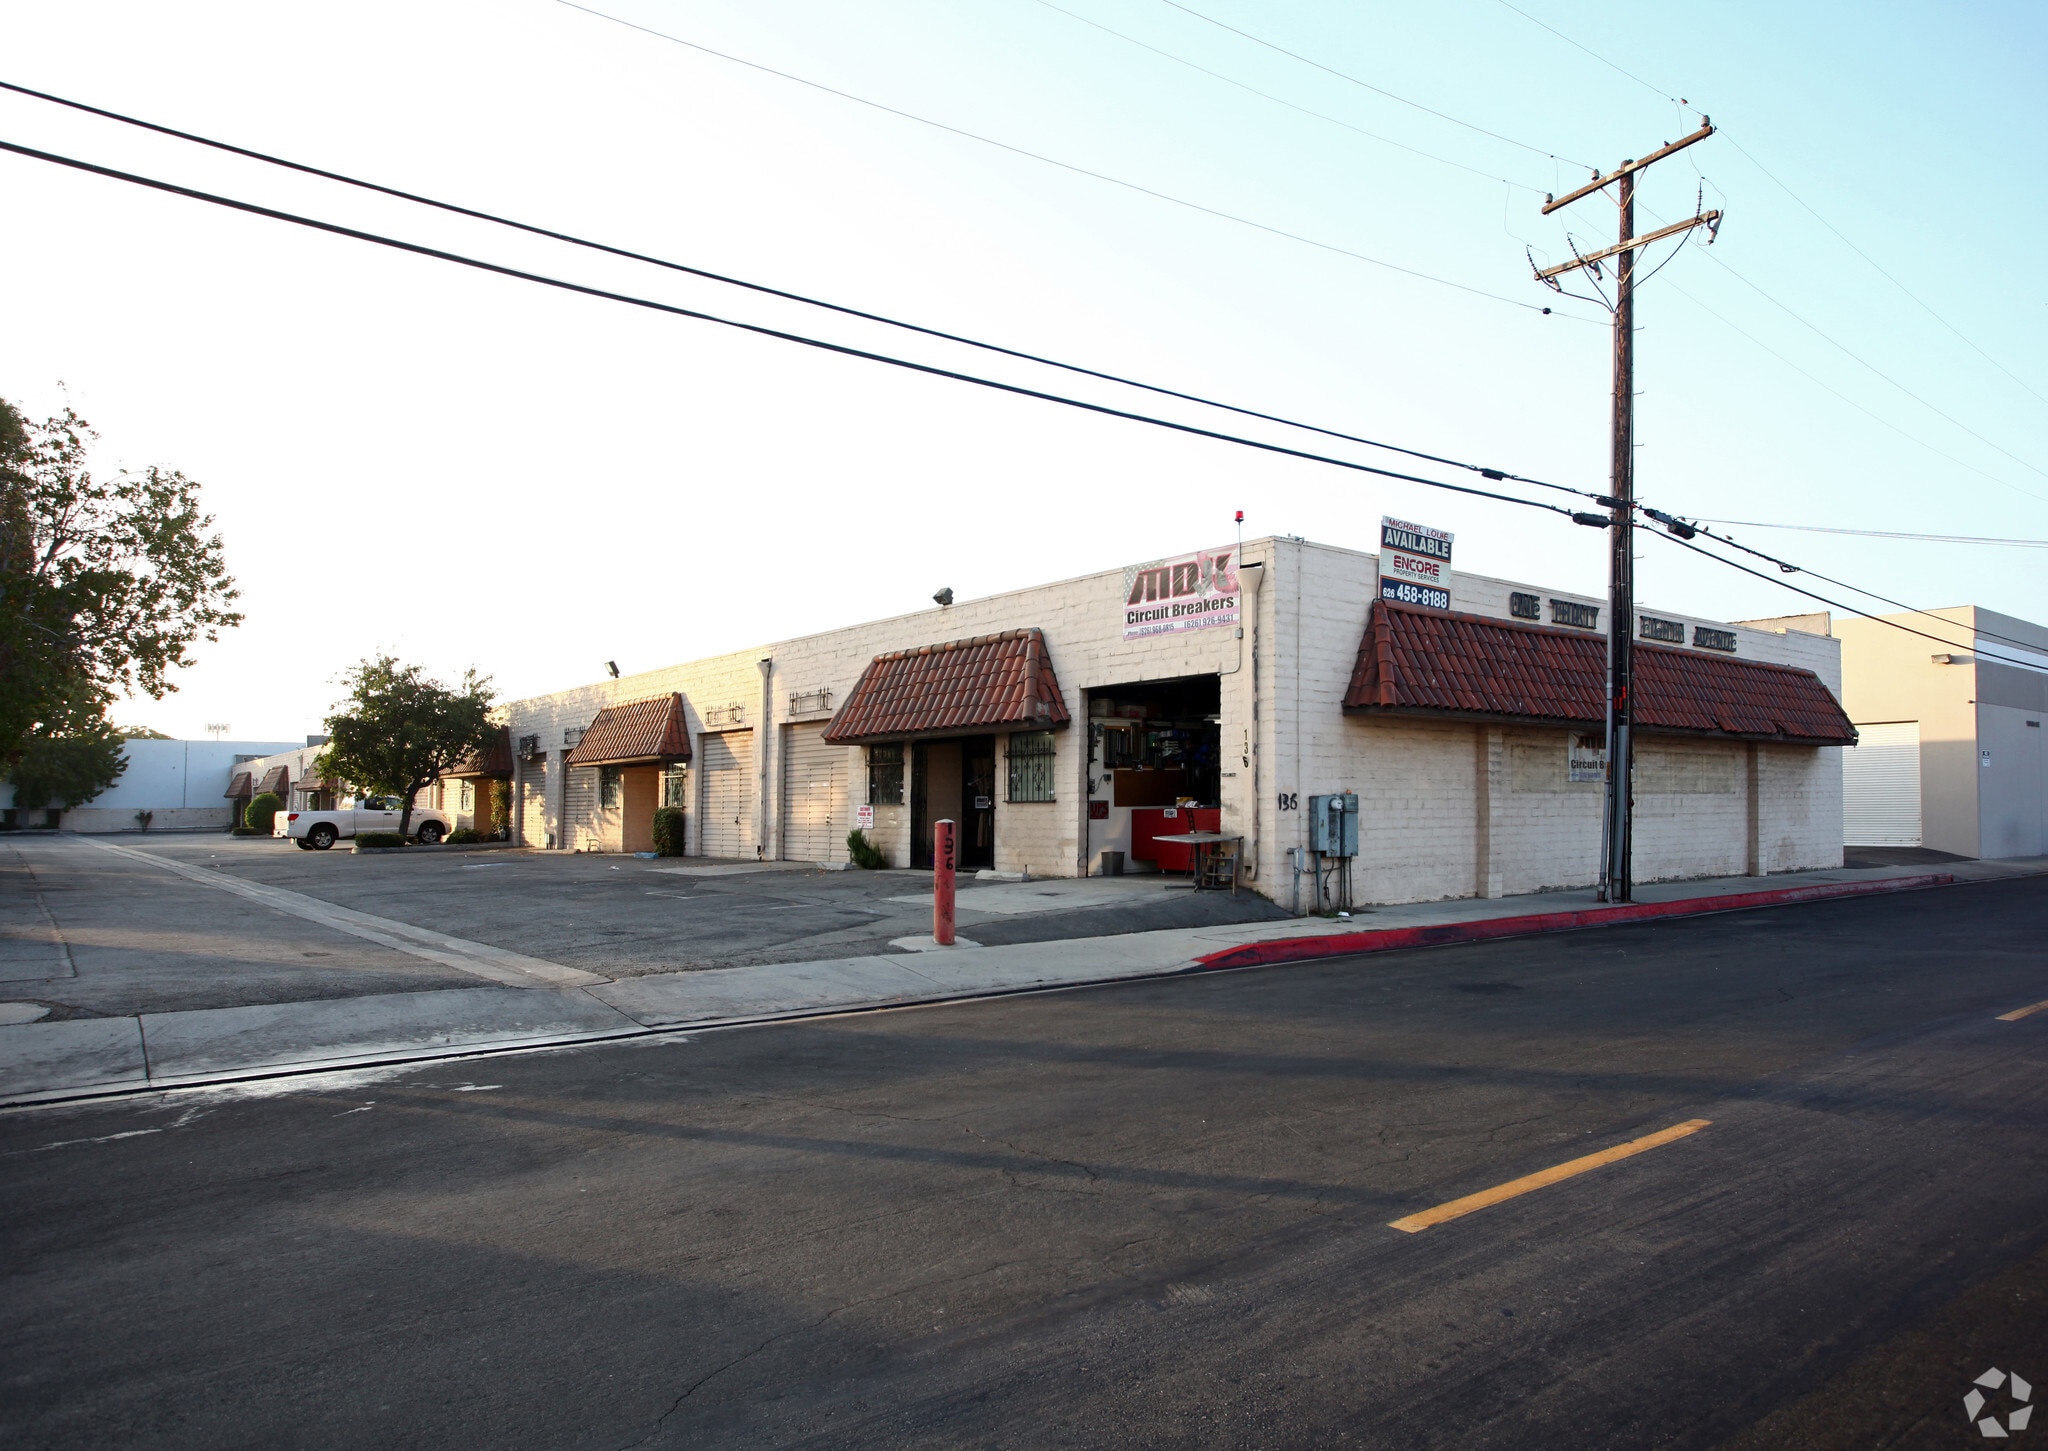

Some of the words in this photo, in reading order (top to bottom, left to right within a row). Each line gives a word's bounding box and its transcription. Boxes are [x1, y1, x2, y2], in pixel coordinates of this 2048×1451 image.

[1389, 519, 1422, 534] MICHAEL
[1426, 529, 1449, 540] LOUIE
[1385, 528, 1449, 557] AVAILABLE
[1393, 555, 1439, 577] ENCORE
[1393, 568, 1417, 579] PROPERTY
[1417, 573, 1439, 584] SERVICES
[1382, 587, 1395, 598] 626
[1397, 584, 1447, 609] 458-8188
[1510, 592, 1540, 620] ONE
[1127, 606, 1169, 624] Circuit
[1172, 596, 1234, 617] Breakers
[1570, 760, 1598, 769] Circuit
[1278, 793, 1298, 811] 136
[944, 822, 954, 870] 136
